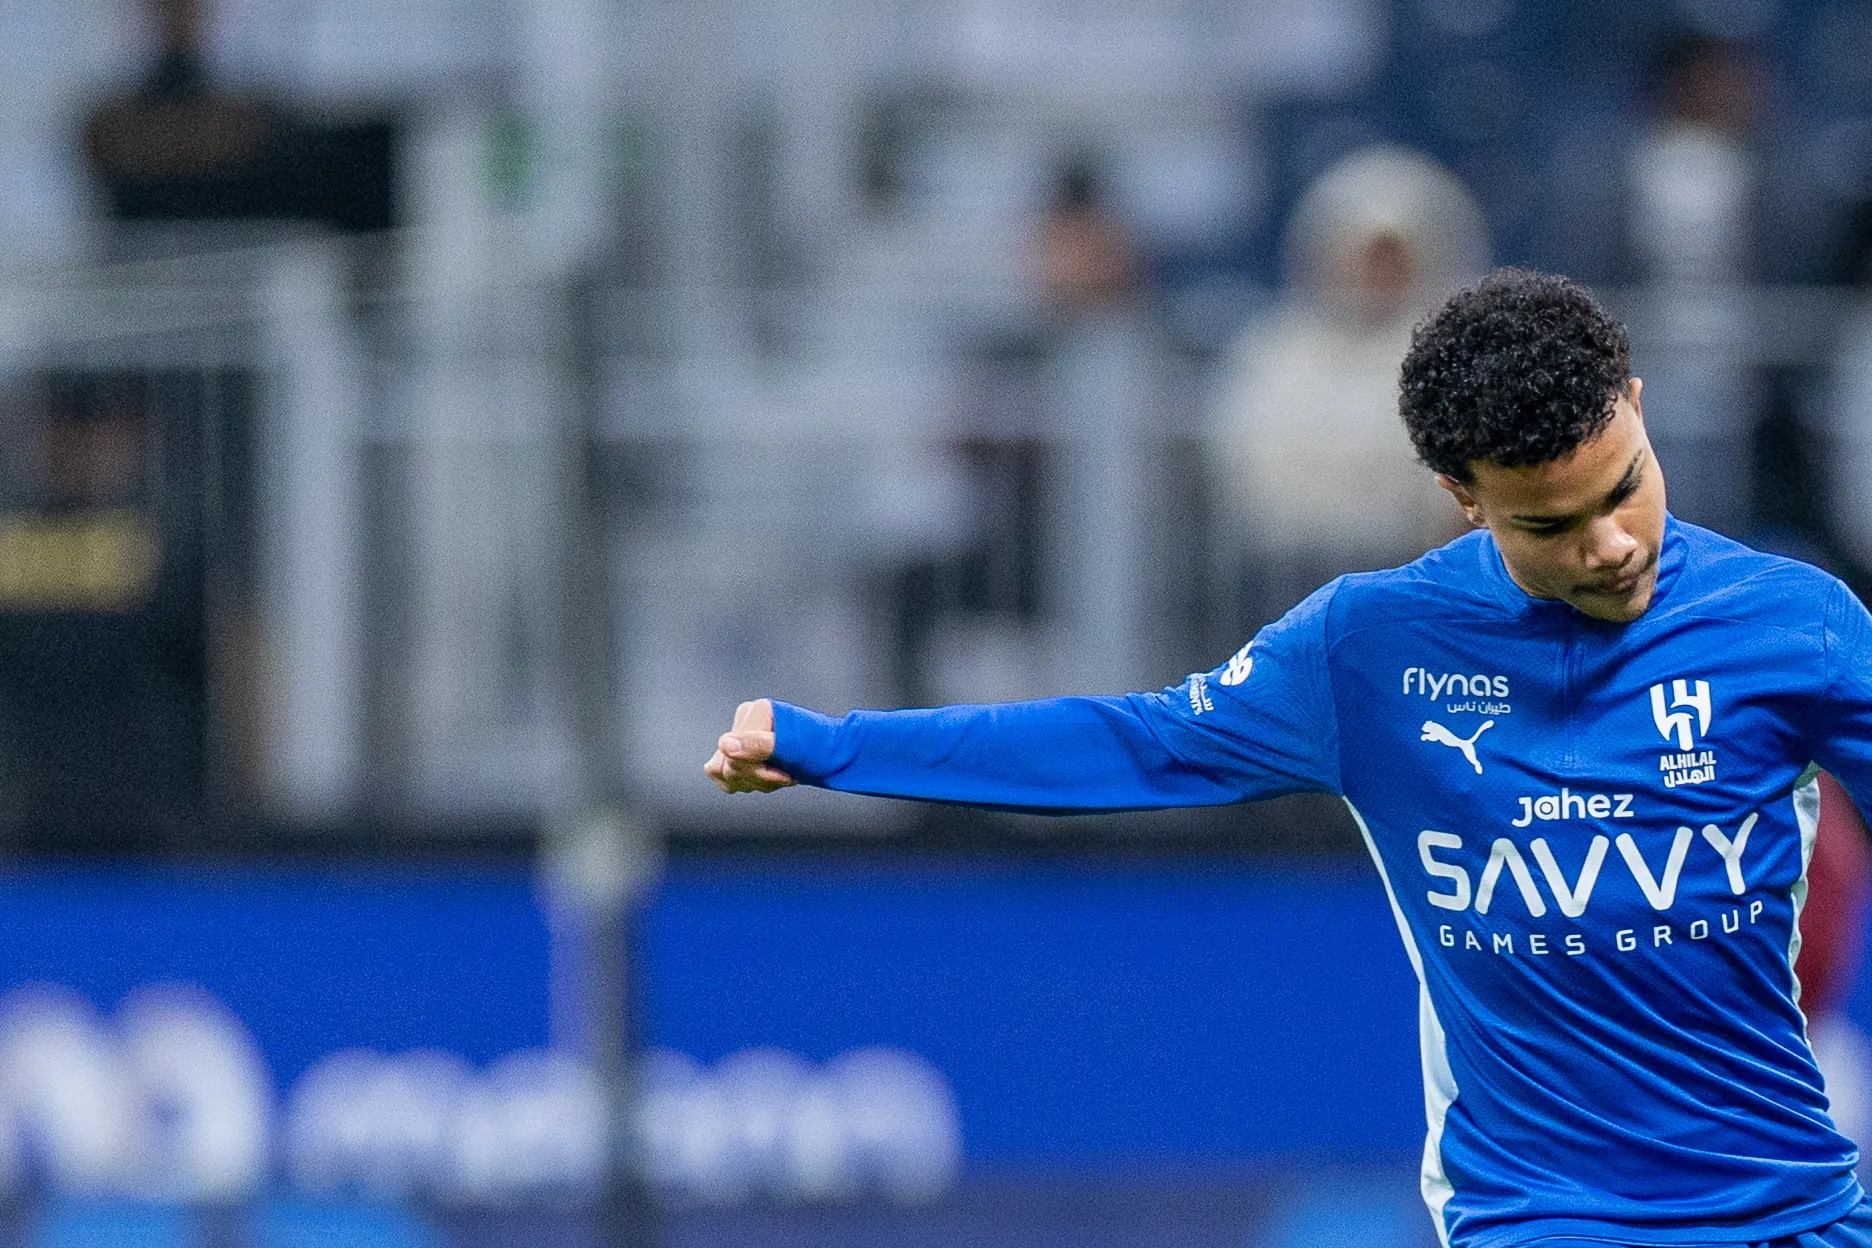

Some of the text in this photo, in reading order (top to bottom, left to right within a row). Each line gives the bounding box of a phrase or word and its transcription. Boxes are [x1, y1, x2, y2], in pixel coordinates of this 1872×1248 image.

[1403, 667, 1509, 701] flynas
[1660, 750, 1717, 771] ALHILAL
[1512, 788, 1634, 827] jahez
[1417, 812, 1759, 918] SAVVY
[1439, 900, 1763, 956] GAMES GROUP
